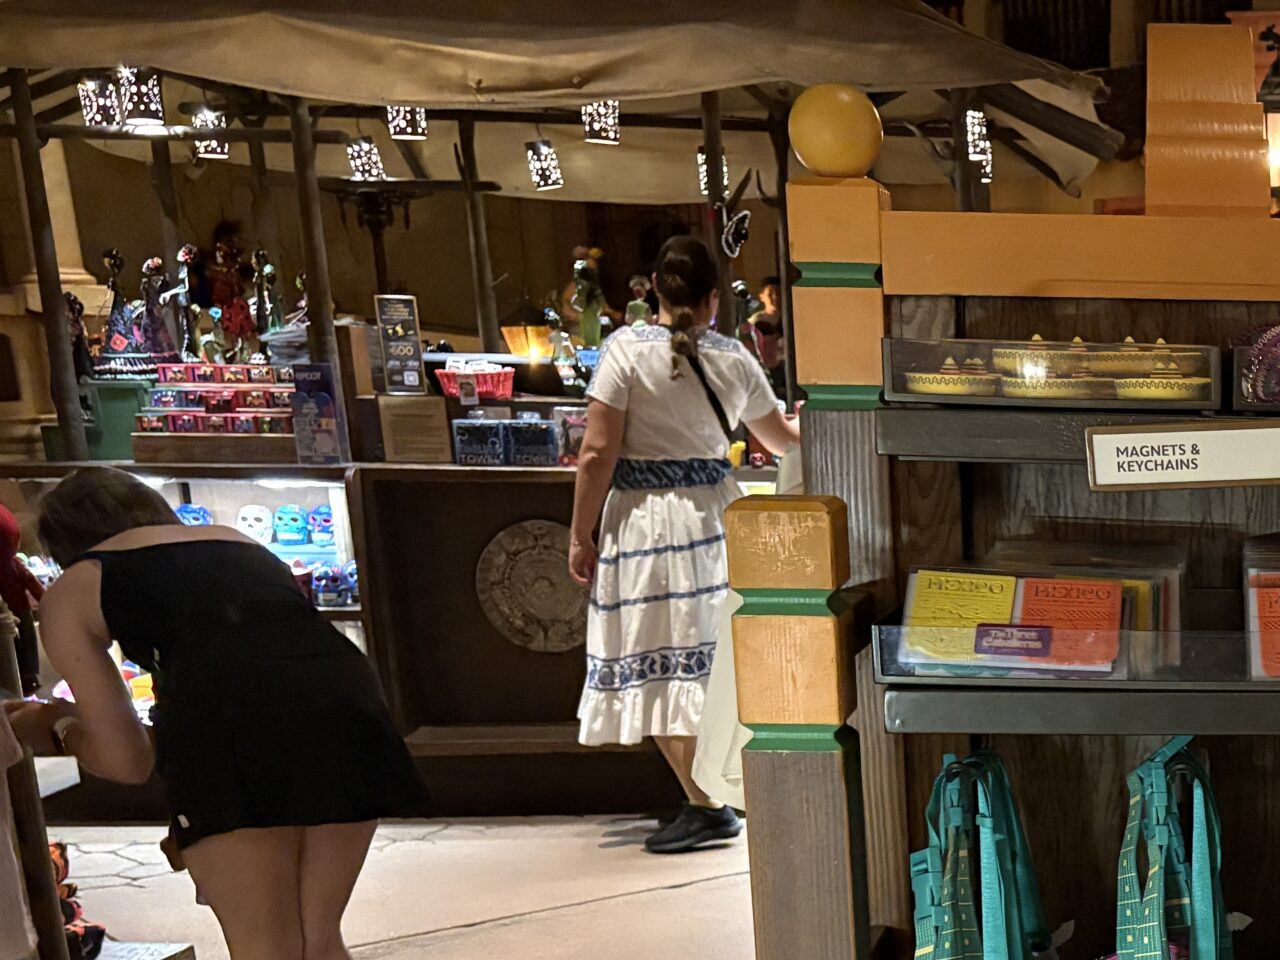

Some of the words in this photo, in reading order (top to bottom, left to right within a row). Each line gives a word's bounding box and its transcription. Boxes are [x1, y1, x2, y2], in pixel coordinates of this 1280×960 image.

[1115, 445, 1186, 459] MAGNETS
[1190, 443, 1201, 455] &
[1116, 458, 1199, 473] KEYCHAINS
